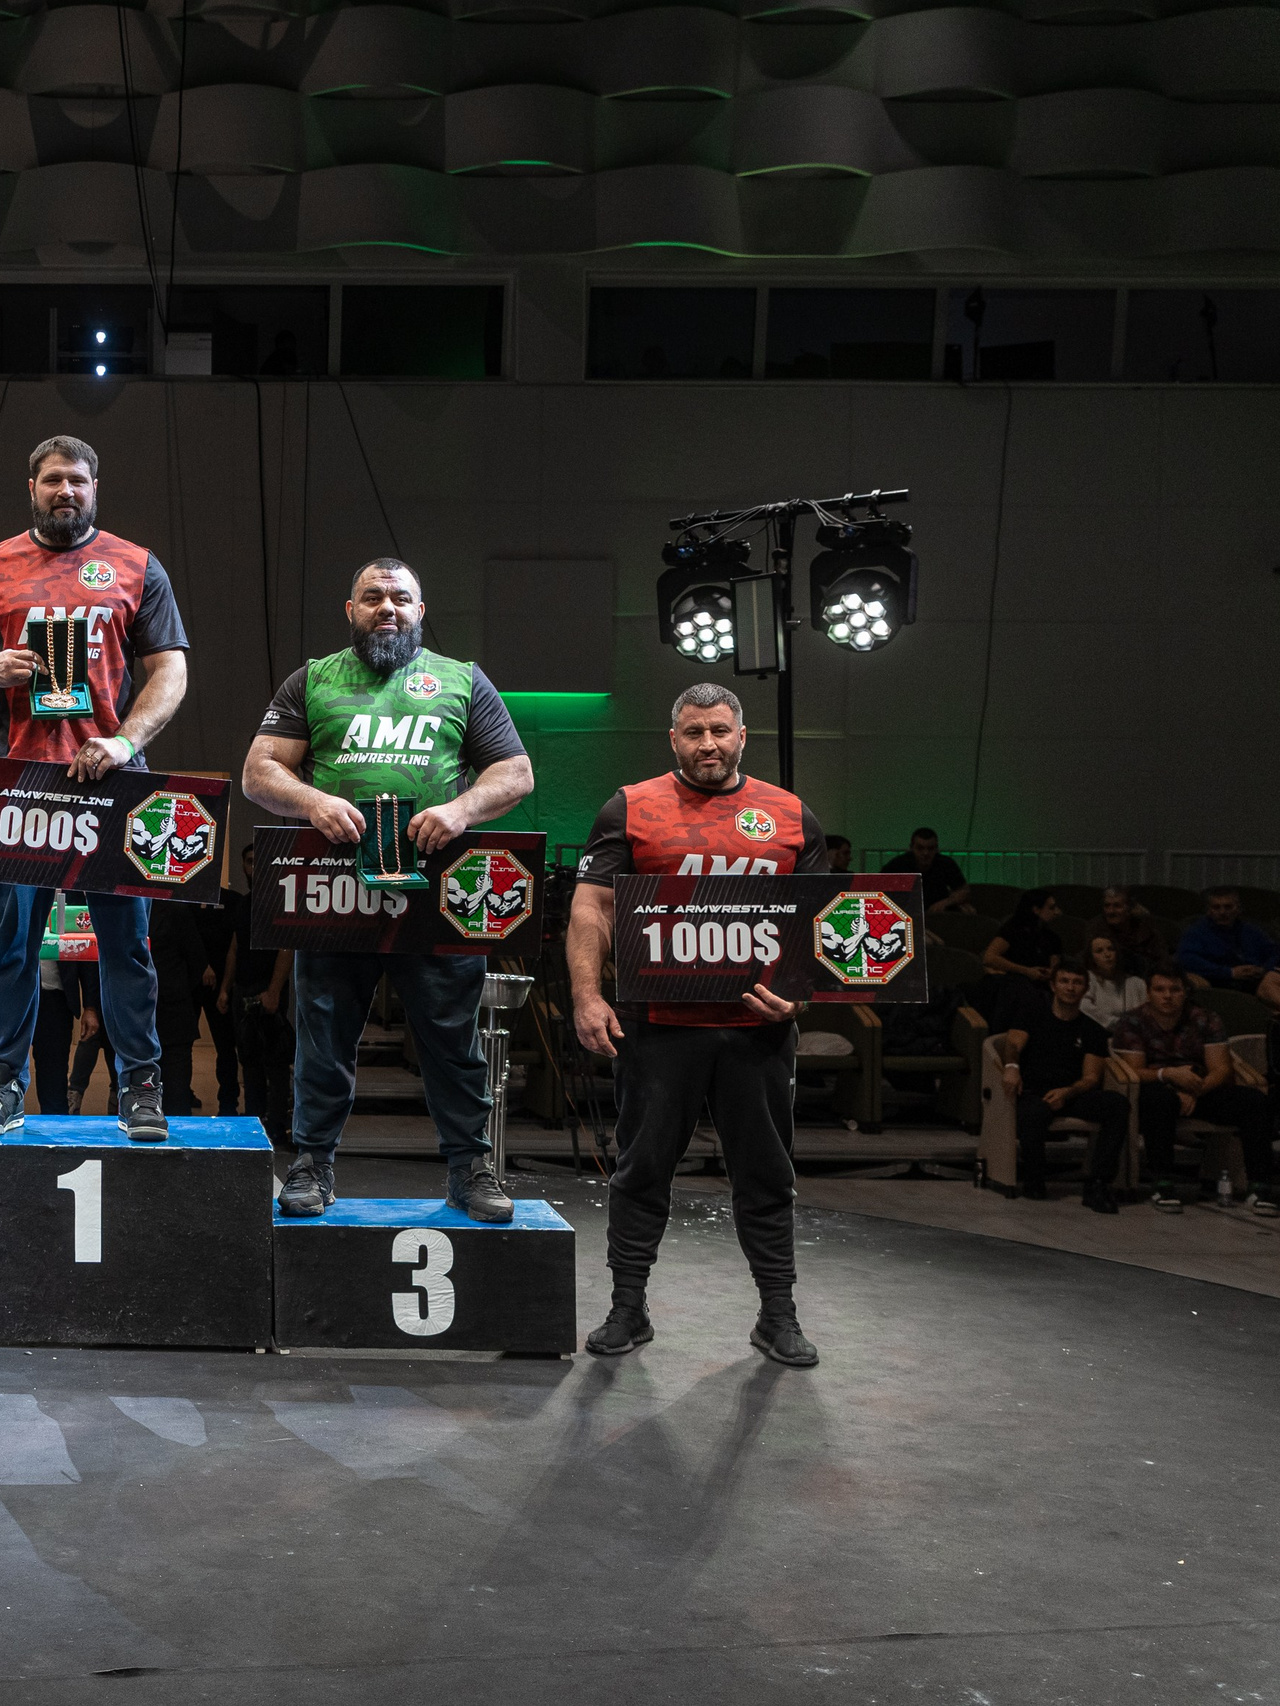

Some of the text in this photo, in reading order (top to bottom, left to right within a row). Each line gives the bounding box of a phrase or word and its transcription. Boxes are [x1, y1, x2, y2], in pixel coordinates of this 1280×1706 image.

[341, 714, 442, 751] AMC
[334, 752, 431, 766] ARMWRESTLING
[0, 788, 115, 807] ARMWRESTLING
[271, 857, 305, 866] AMC
[633, 904, 798, 914] AMC ARMWRESTLING
[57, 1159, 102, 1263] 1
[391, 1228, 455, 1336] 3
